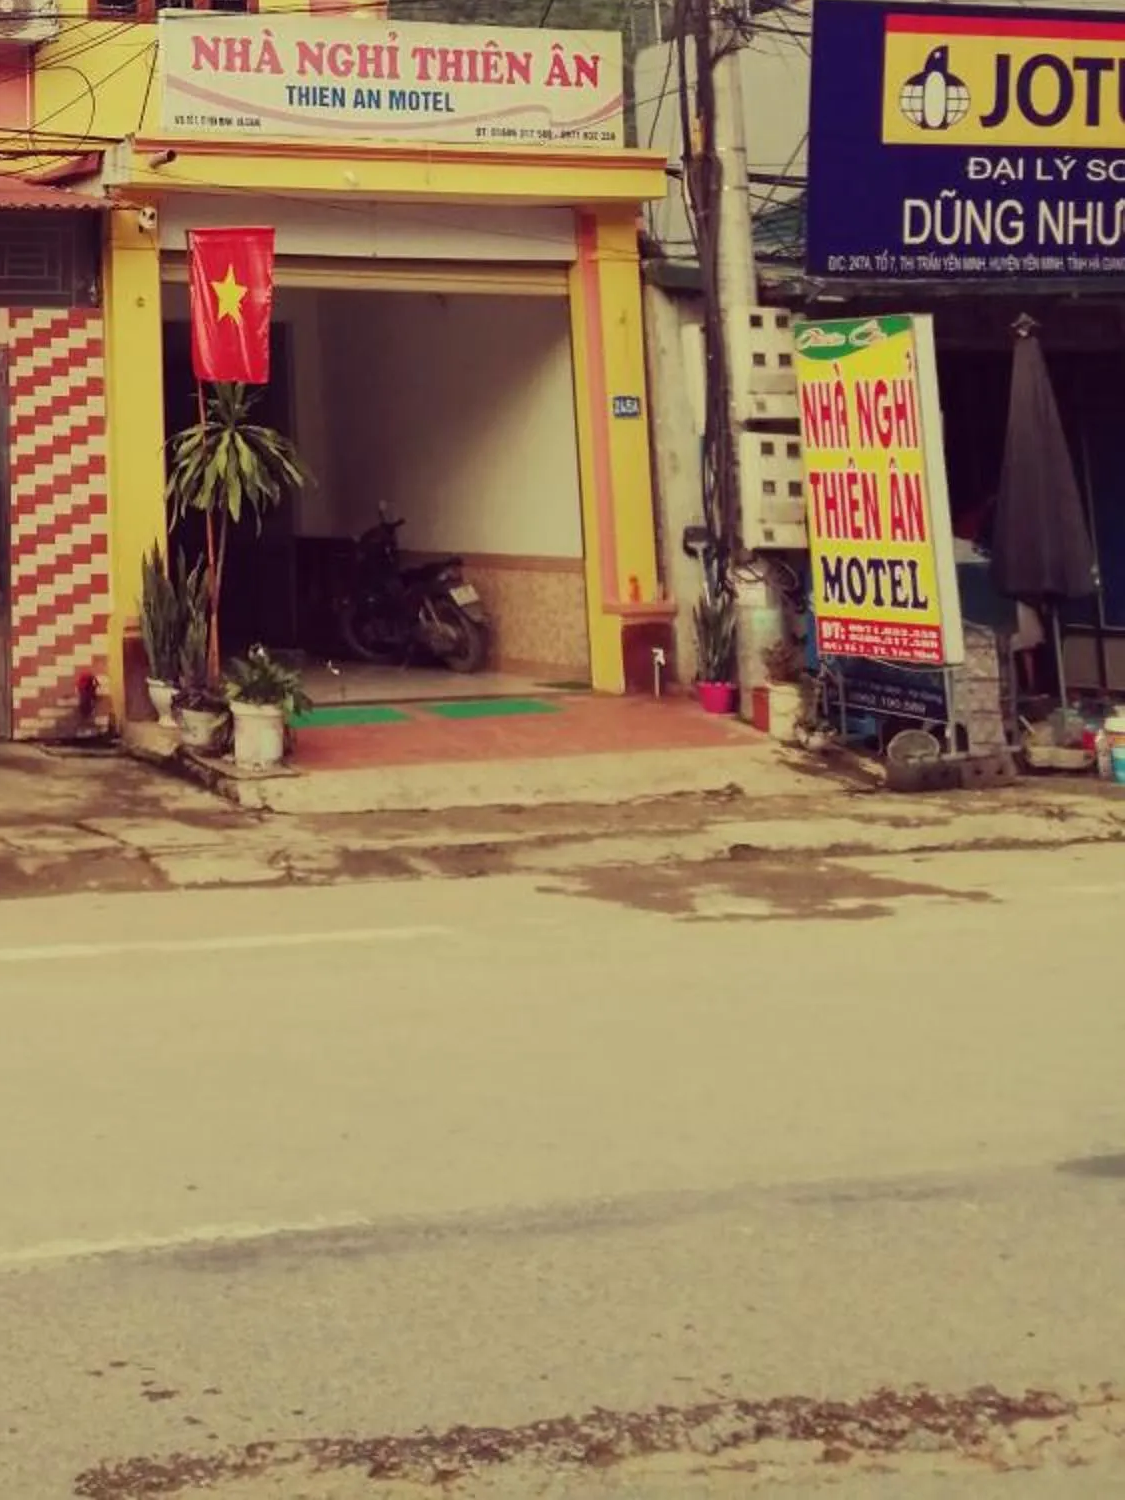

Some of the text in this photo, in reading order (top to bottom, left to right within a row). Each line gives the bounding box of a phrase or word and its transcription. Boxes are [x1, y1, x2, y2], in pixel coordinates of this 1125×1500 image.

[191, 28, 601, 88] NHÀ NGHỈ THIÊN ÂN
[286, 85, 456, 113] THIEN AN MOTEL
[978, 53, 1125, 128] JOT
[967, 156, 1024, 185] ĐẠI
[1036, 155, 1077, 181] LÝ
[903, 189, 1125, 246] DŨNG NHƯ
[802, 350, 919, 449] NHÀ NGHỈ
[809, 456, 926, 542] THIÊN ÂN
[820, 555, 928, 610] MOTEL
